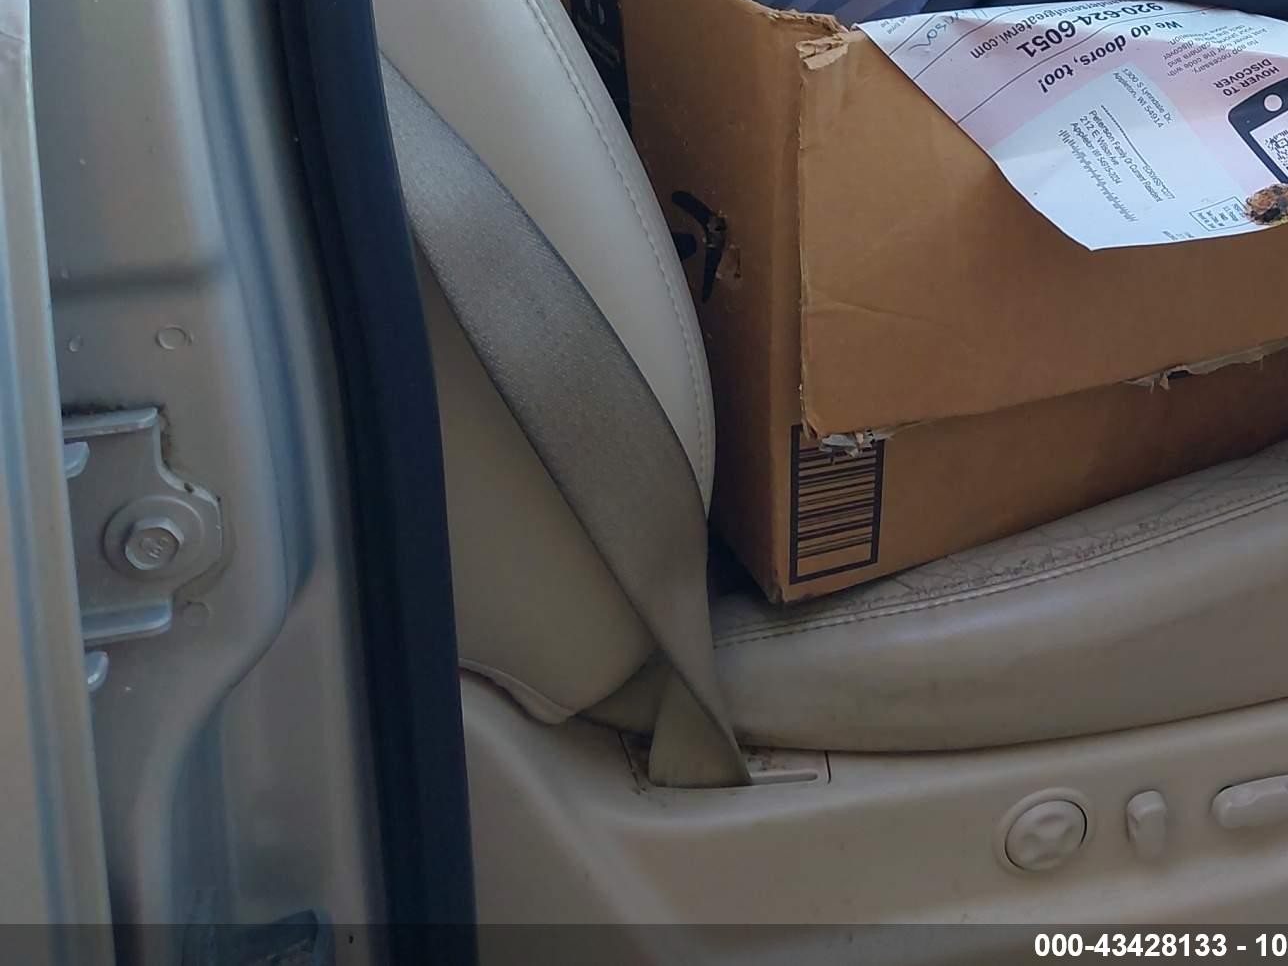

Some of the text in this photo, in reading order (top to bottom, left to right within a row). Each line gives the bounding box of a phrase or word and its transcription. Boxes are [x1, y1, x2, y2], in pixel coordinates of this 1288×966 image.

[1016, 2, 1164, 59] 920-624-6051
[1039, 20, 1183, 93] We do doors, too!
[1163, 40, 1194, 60] discover
[1183, 42, 1212, 60] camera
[1203, 50, 1217, 60] the
[1232, 44, 1247, 55] app
[1167, 57, 1183, 68] and
[1167, 66, 1184, 77] with
[1183, 57, 1202, 69] code
[1192, 53, 1232, 74] necessary.
[1214, 58, 1272, 89] DISCOVER
[1223, 66, 1280, 97] HOVER TO
[1089, 110, 1115, 142] Peterson
[1144, 104, 1164, 128] 54914
[1080, 116, 1095, 131] 212
[1092, 129, 1100, 138] E
